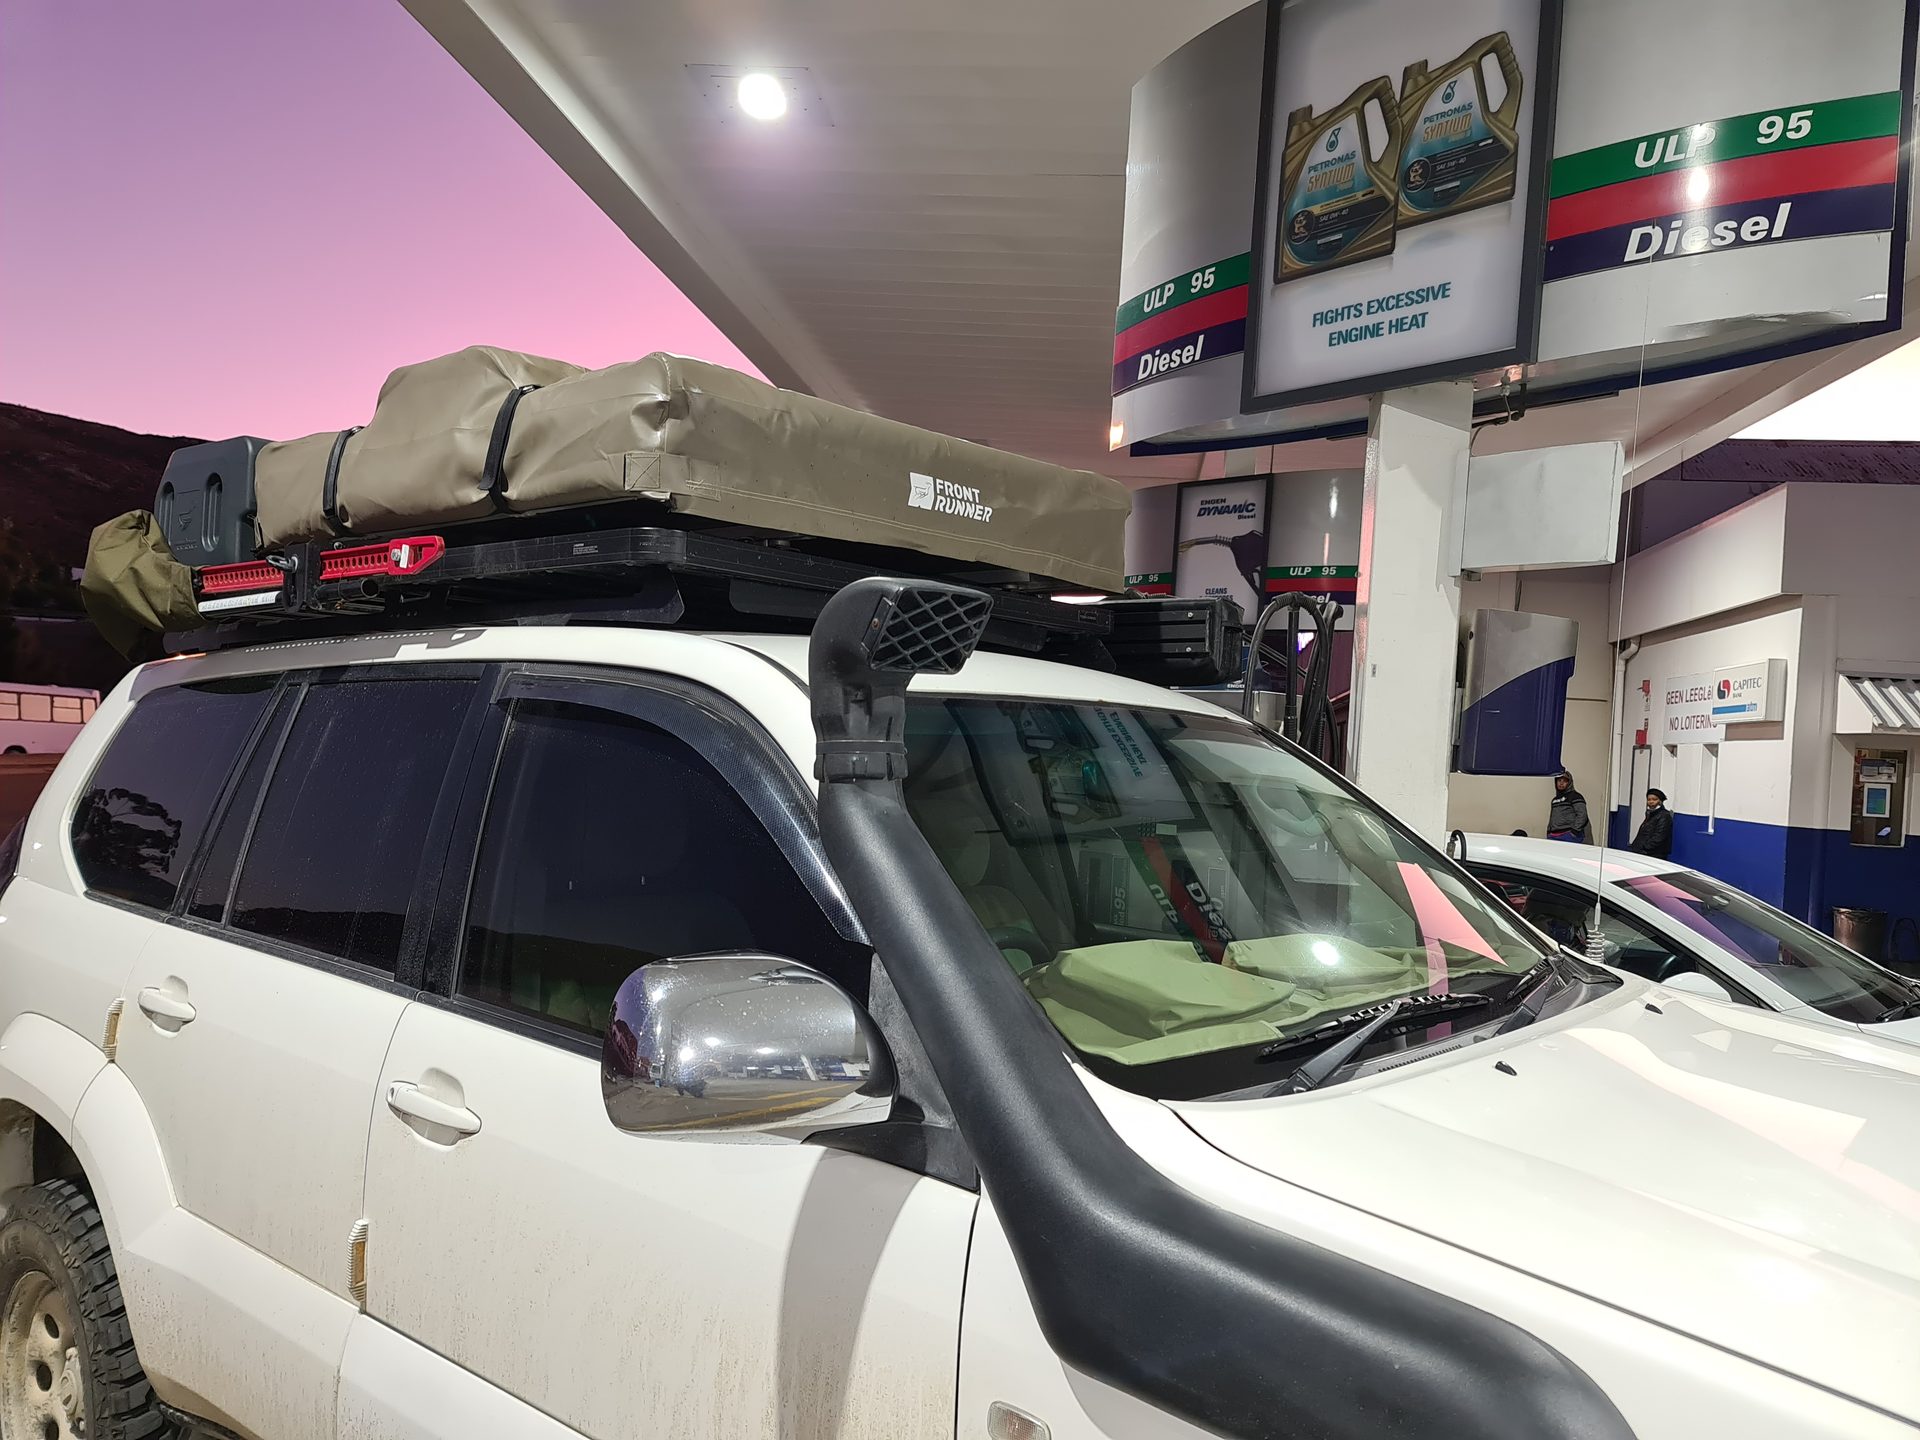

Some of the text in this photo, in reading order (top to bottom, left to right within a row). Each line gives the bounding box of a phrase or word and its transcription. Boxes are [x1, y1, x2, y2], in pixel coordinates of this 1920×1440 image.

[1424, 101, 1474, 125] PETRONAS
[1423, 113, 1473, 143] SYNTIUM
[1634, 109, 1814, 169] ULP 95
[1308, 150, 1357, 174] PETRONAS
[1307, 162, 1355, 193] SYNTIUM
[1624, 202, 1792, 263] Diesel
[1143, 266, 1216, 314] ULP 95
[1312, 281, 1452, 328] FIGHTS EXCESSIVE
[1328, 312, 1430, 348] ENGINE HEAT
[1137, 335, 1205, 382] Diesel
[935, 478, 981, 504] FRONT
[1200, 498, 1227, 506] ENGEN
[934, 495, 993, 523] RUNNER
[1196, 500, 1256, 517] DYNAMIC
[1129, 574, 1159, 584] ULP 95
[1290, 566, 1337, 576] ULP 95
[1205, 587, 1228, 595] CLEANS
[1733, 677, 1763, 692] CAPITEC
[1665, 690, 1683, 705] GEEN
[1669, 716, 1679, 731] NO
